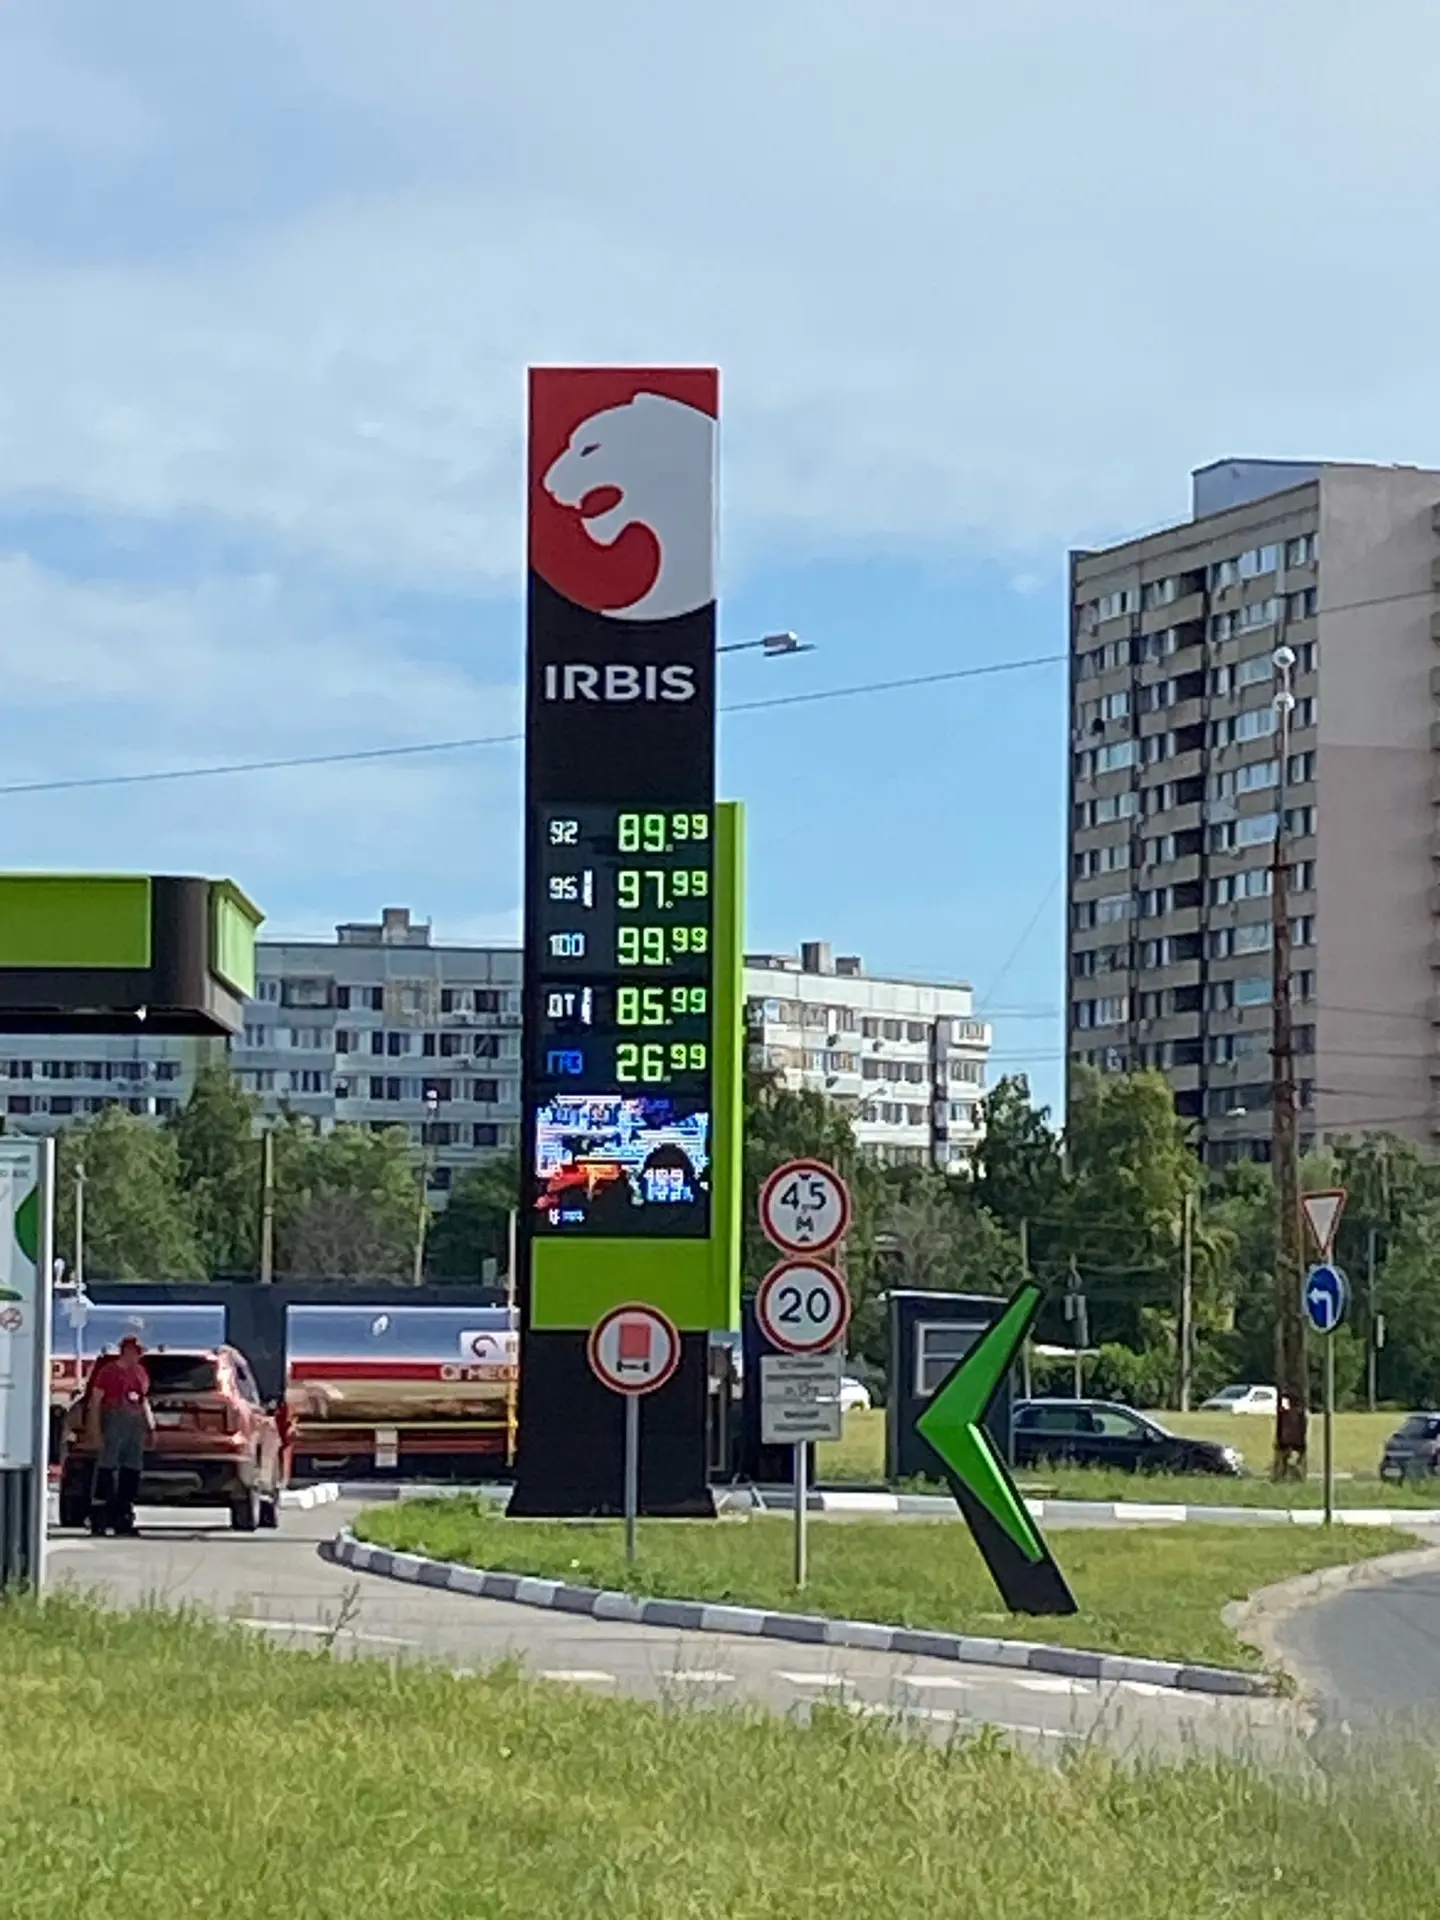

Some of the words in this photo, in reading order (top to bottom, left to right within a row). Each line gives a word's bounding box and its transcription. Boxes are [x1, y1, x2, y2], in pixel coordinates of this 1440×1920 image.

[545, 664, 696, 701] IRBIS
[549, 820, 578, 845] 92
[549, 876, 578, 900] 95
[549, 932, 585, 957] 100
[547, 993, 576, 1018] ДТ
[778, 1287, 831, 1324] 20
